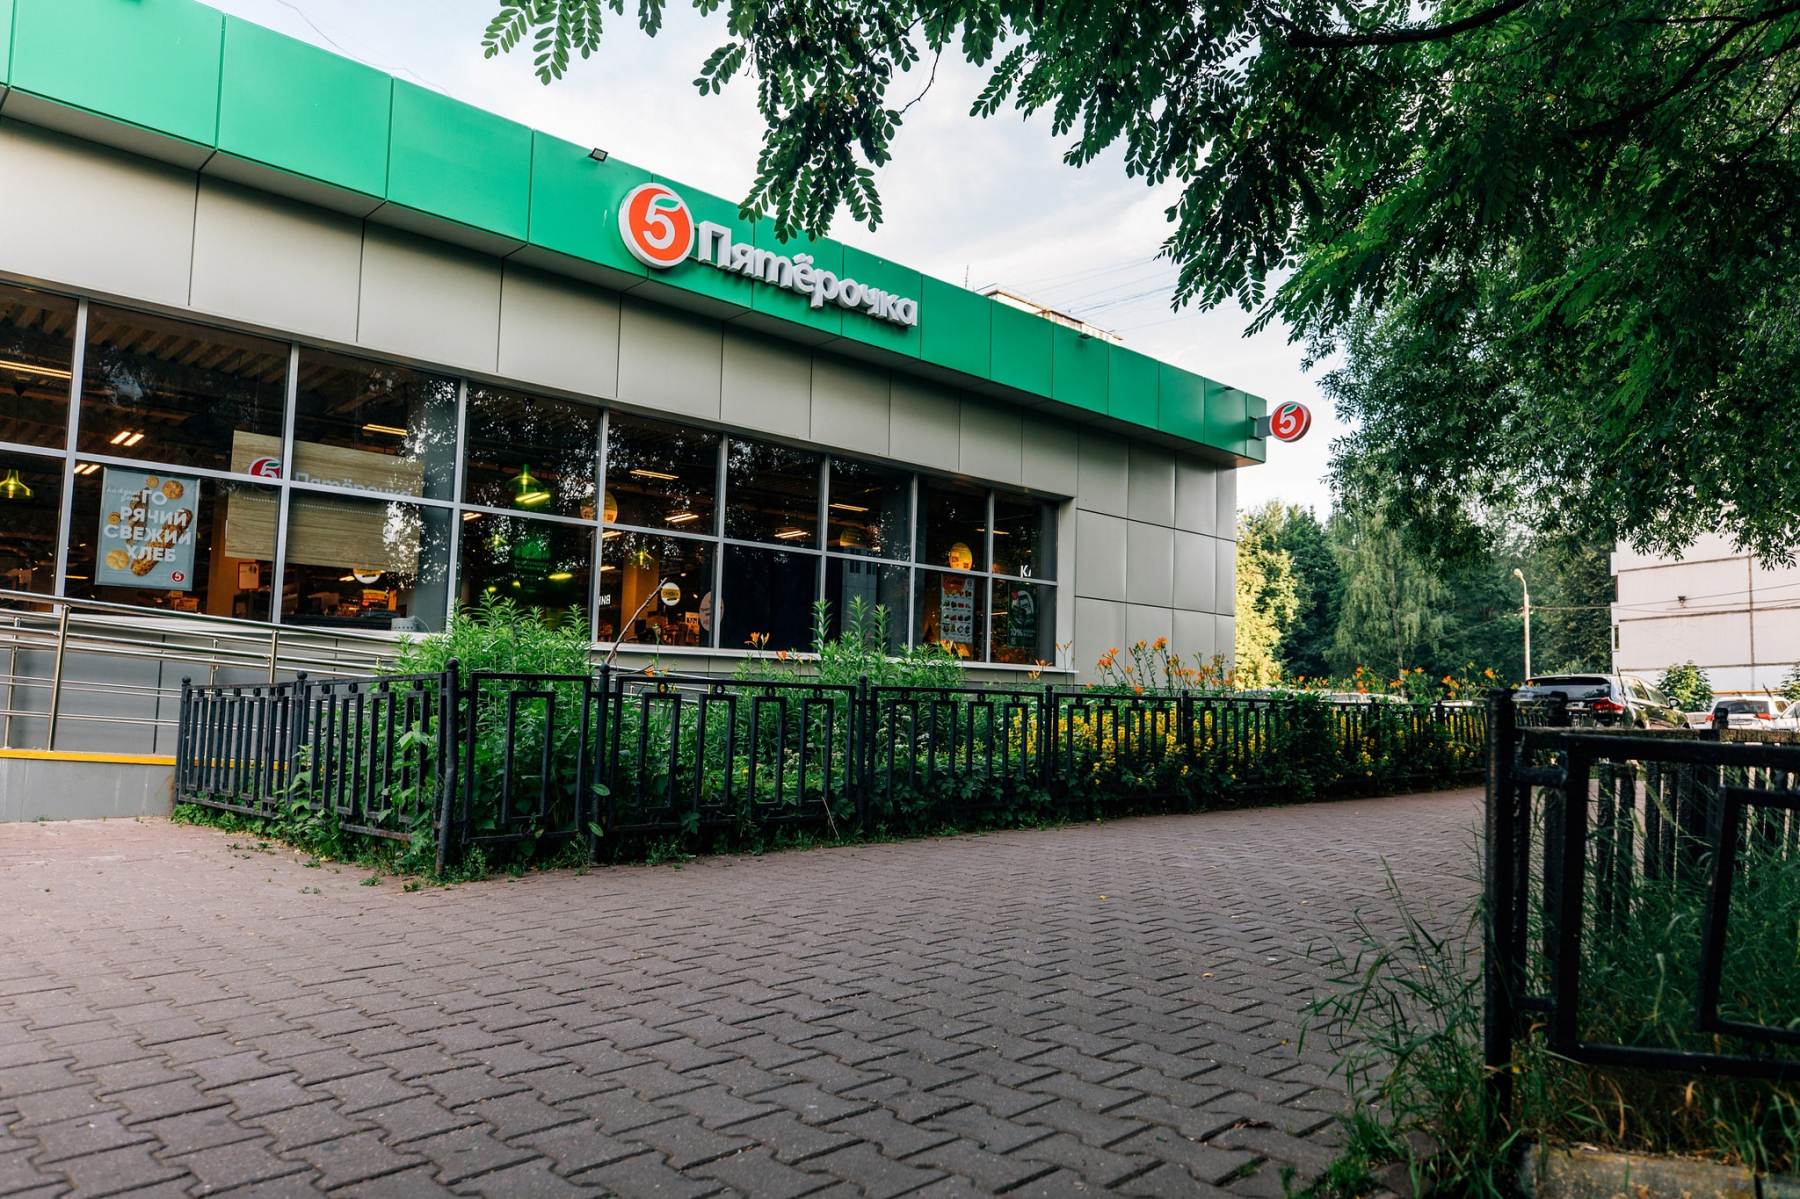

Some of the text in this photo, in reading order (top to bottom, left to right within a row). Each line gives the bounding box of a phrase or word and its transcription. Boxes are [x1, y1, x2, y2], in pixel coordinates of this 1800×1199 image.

[642, 193, 918, 327] 5 Пятёрочка
[142, 489, 168, 505] ГО
[120, 506, 187, 526] РЯЧИЙ
[103, 524, 191, 545] СВЕЖИЙ
[125, 544, 176, 562] ХЛЕБ
